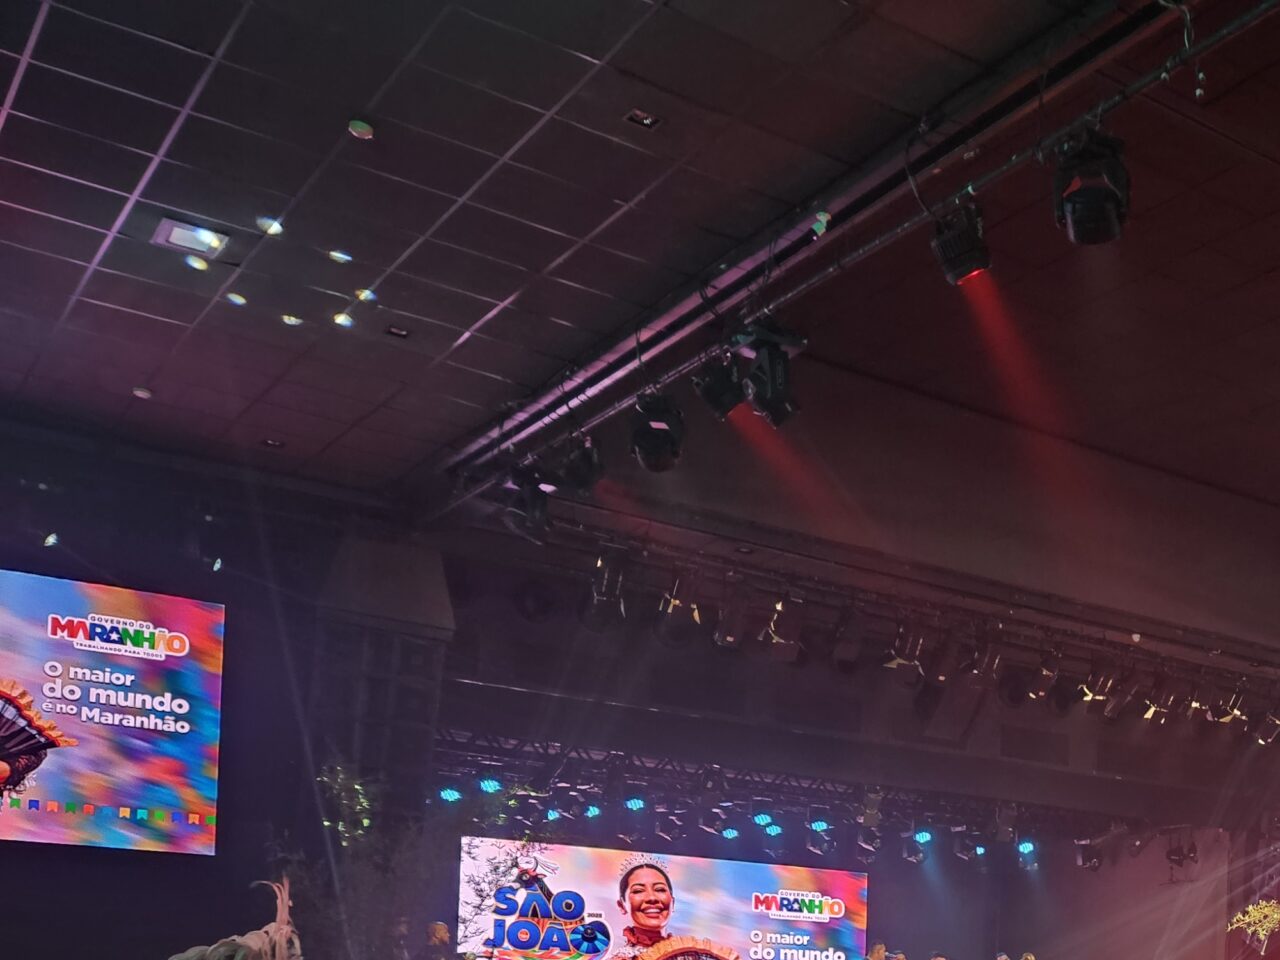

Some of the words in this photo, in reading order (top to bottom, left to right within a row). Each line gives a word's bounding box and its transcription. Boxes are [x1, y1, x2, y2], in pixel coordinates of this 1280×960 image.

[90, 615, 135, 628] GOVERNO
[50, 616, 187, 654] MARANHÃO
[75, 642, 122, 653] TRABALHANDO
[43, 661, 63, 677] O
[69, 666, 135, 686] maior
[42, 678, 81, 700] do
[89, 687, 190, 714] mundo
[56, 703, 78, 714] no
[81, 706, 190, 734] Maranhão
[493, 883, 586, 921] SÃO
[754, 894, 842, 916] MARANHÃO
[482, 919, 611, 955] JOÃO
[750, 930, 763, 942] O
[766, 932, 810, 945] maior
[749, 944, 775, 960] do
